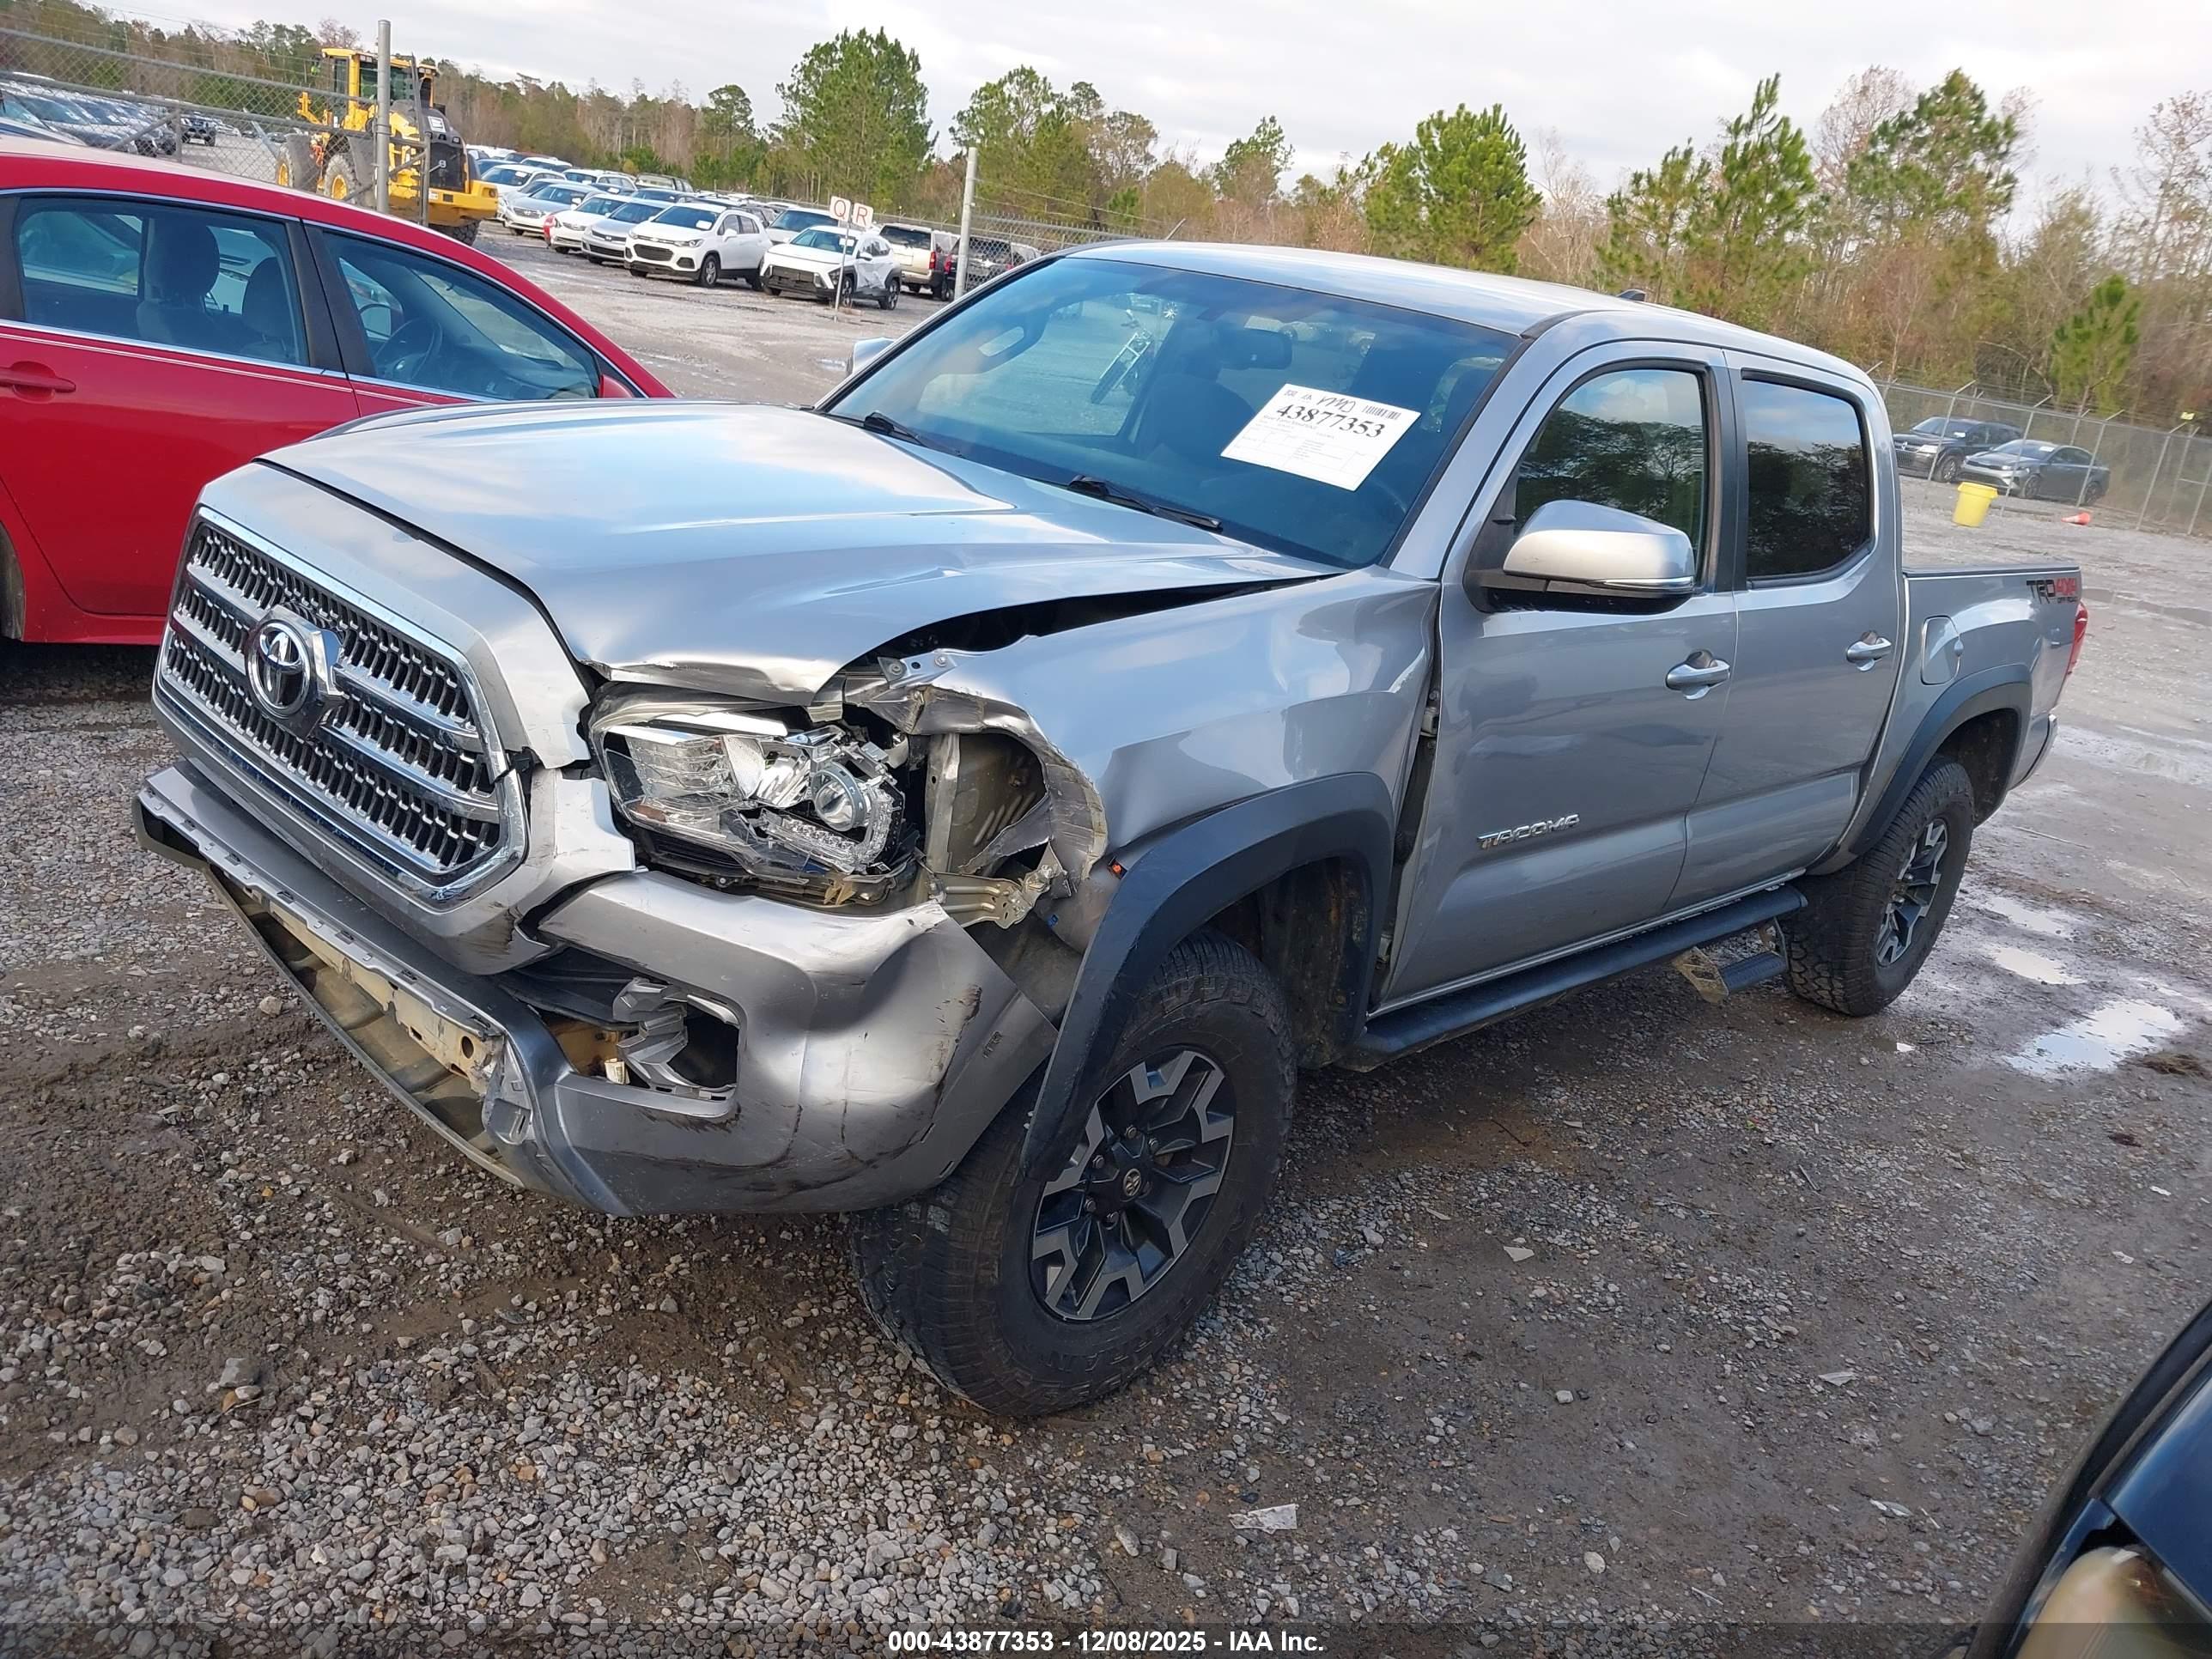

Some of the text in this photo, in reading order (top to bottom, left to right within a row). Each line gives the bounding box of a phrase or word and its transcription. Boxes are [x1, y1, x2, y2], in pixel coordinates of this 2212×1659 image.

[834, 200, 846, 220] Q
[856, 207, 867, 226] R
[1276, 404, 1386, 438] 43877353
[2027, 580, 2055, 604] TRD
[1478, 814, 1580, 849] TACOMA
